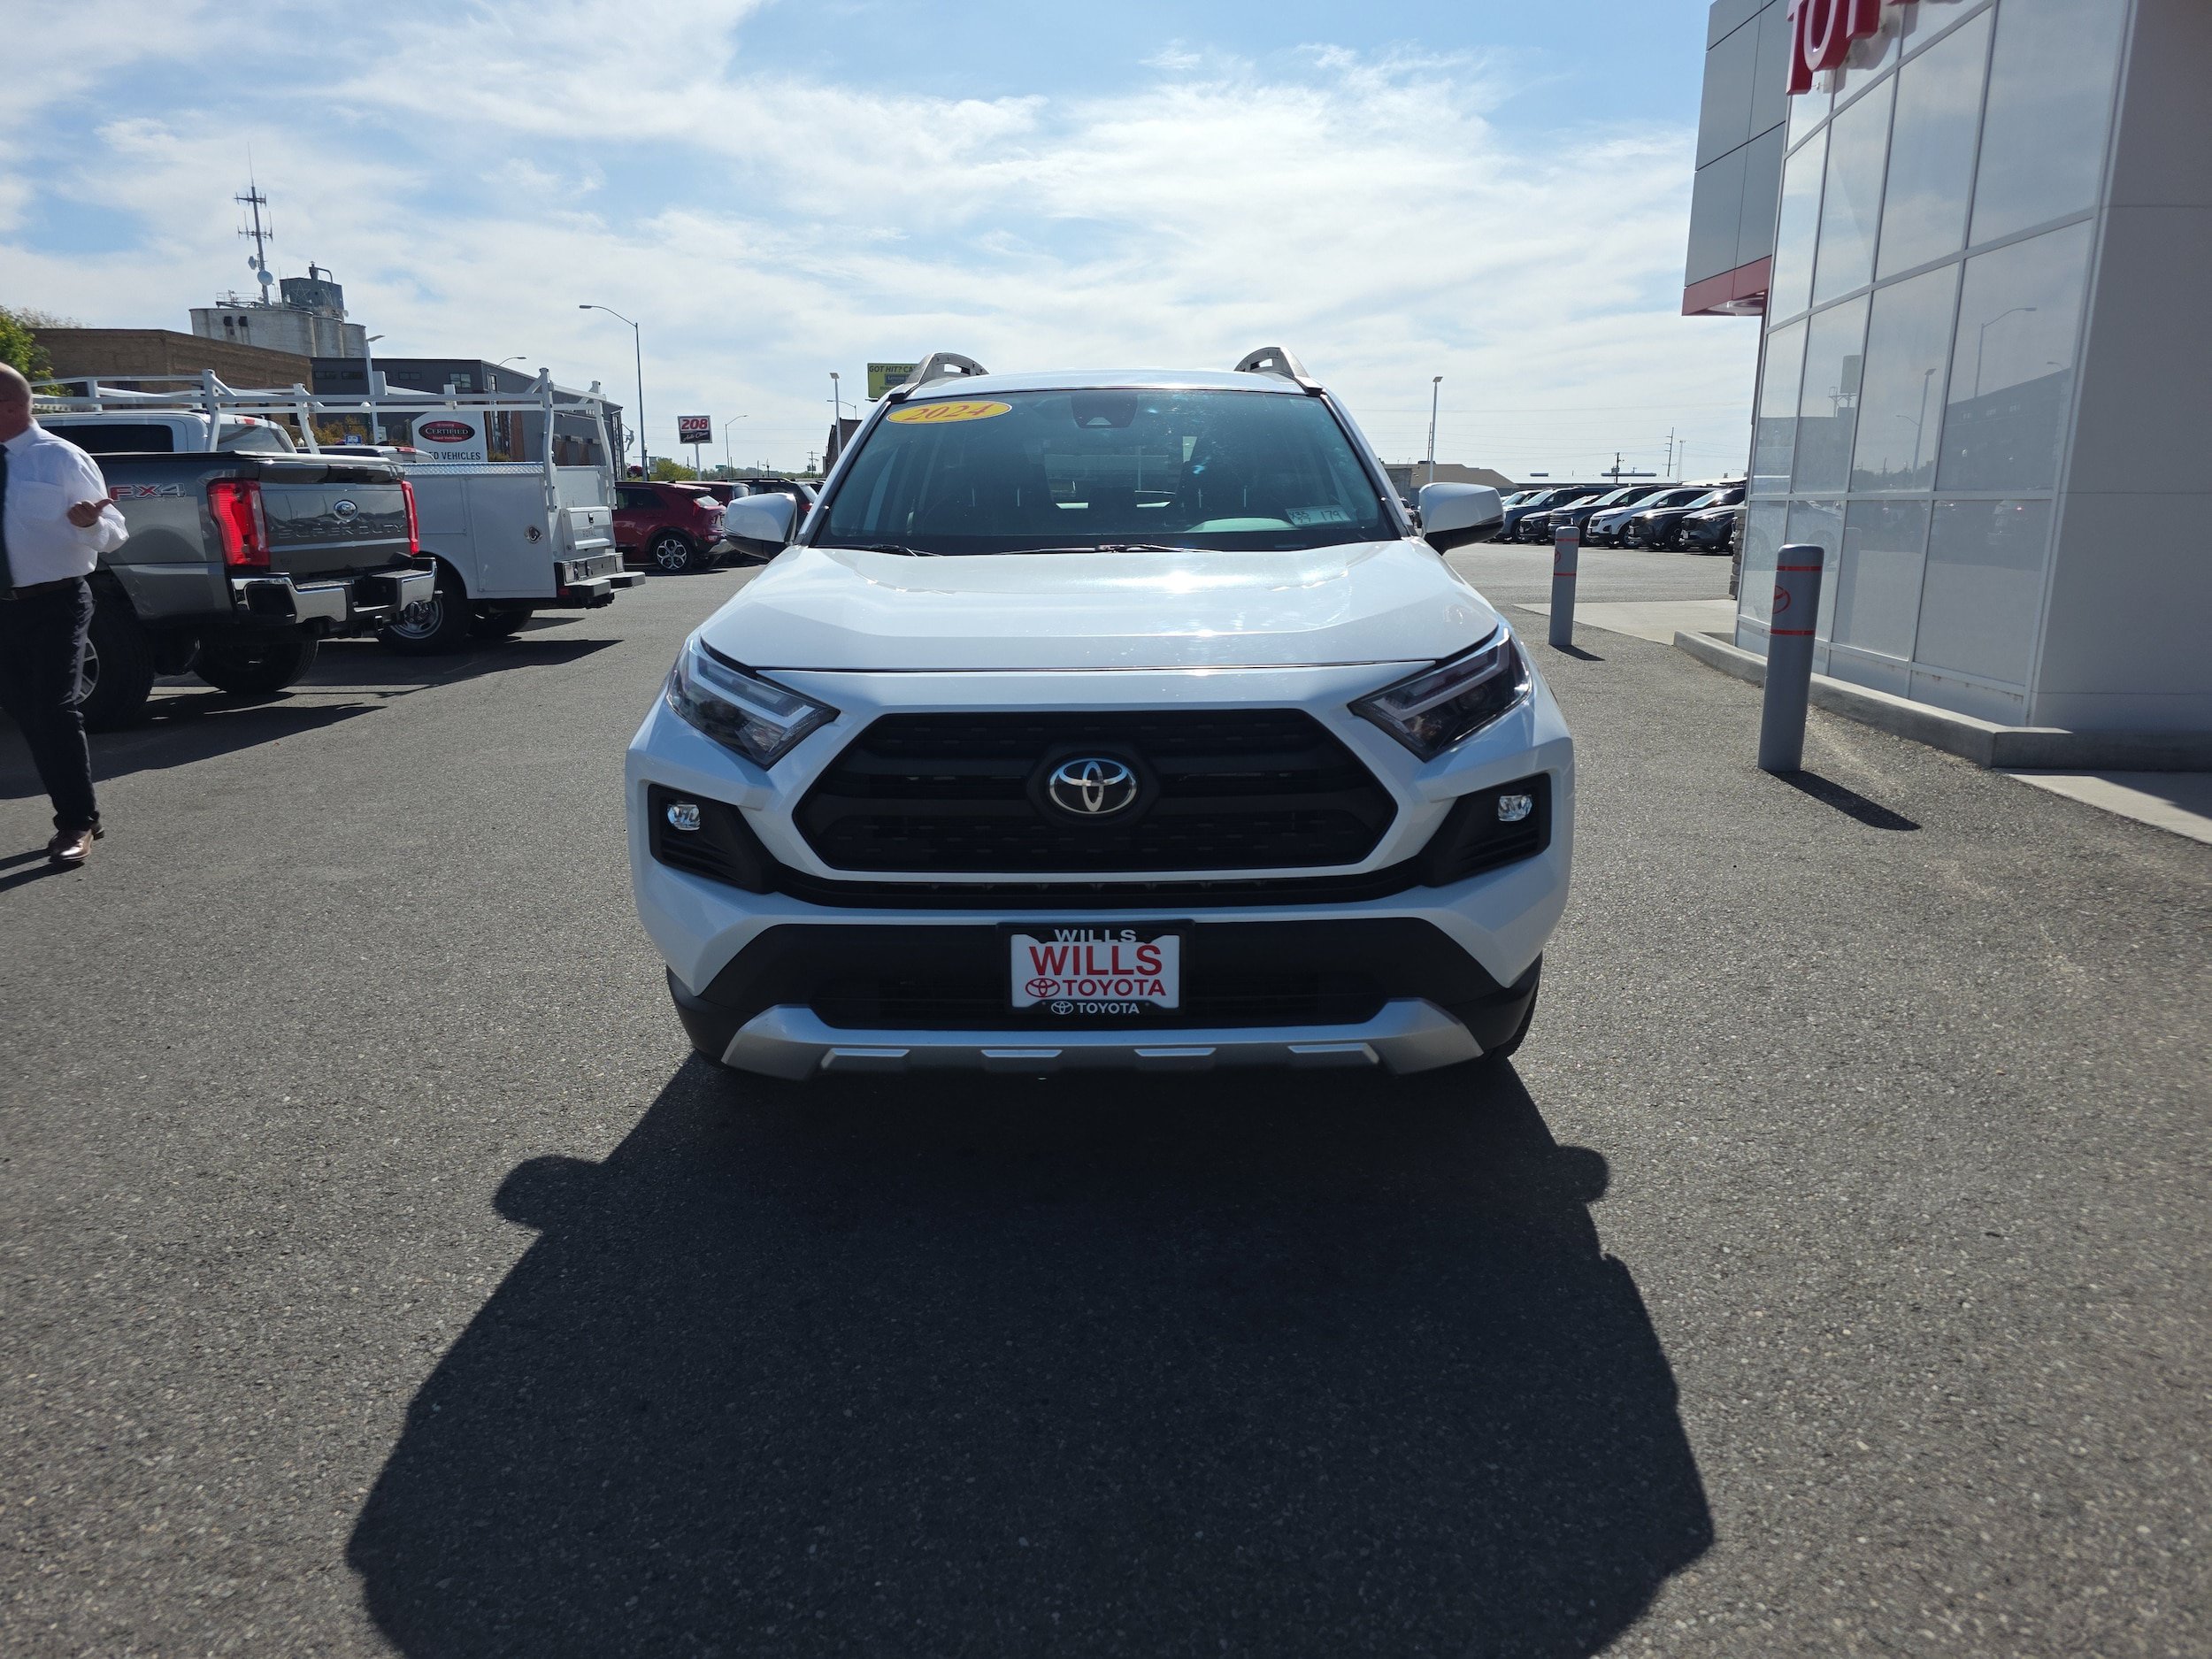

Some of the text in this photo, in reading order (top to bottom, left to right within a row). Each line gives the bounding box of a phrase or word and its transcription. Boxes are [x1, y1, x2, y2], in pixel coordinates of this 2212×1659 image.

[902, 403, 994, 421] 2024
[681, 419, 708, 430] 208
[441, 451, 481, 460] VEHICLES
[108, 483, 187, 503] FX4
[279, 524, 403, 539] SUPER DUTY
[1055, 929, 1137, 943] WILLS
[1029, 944, 1163, 976] WILLS
[1063, 979, 1167, 996] TOYOTA
[1077, 1002, 1141, 1014] TOYOTA
